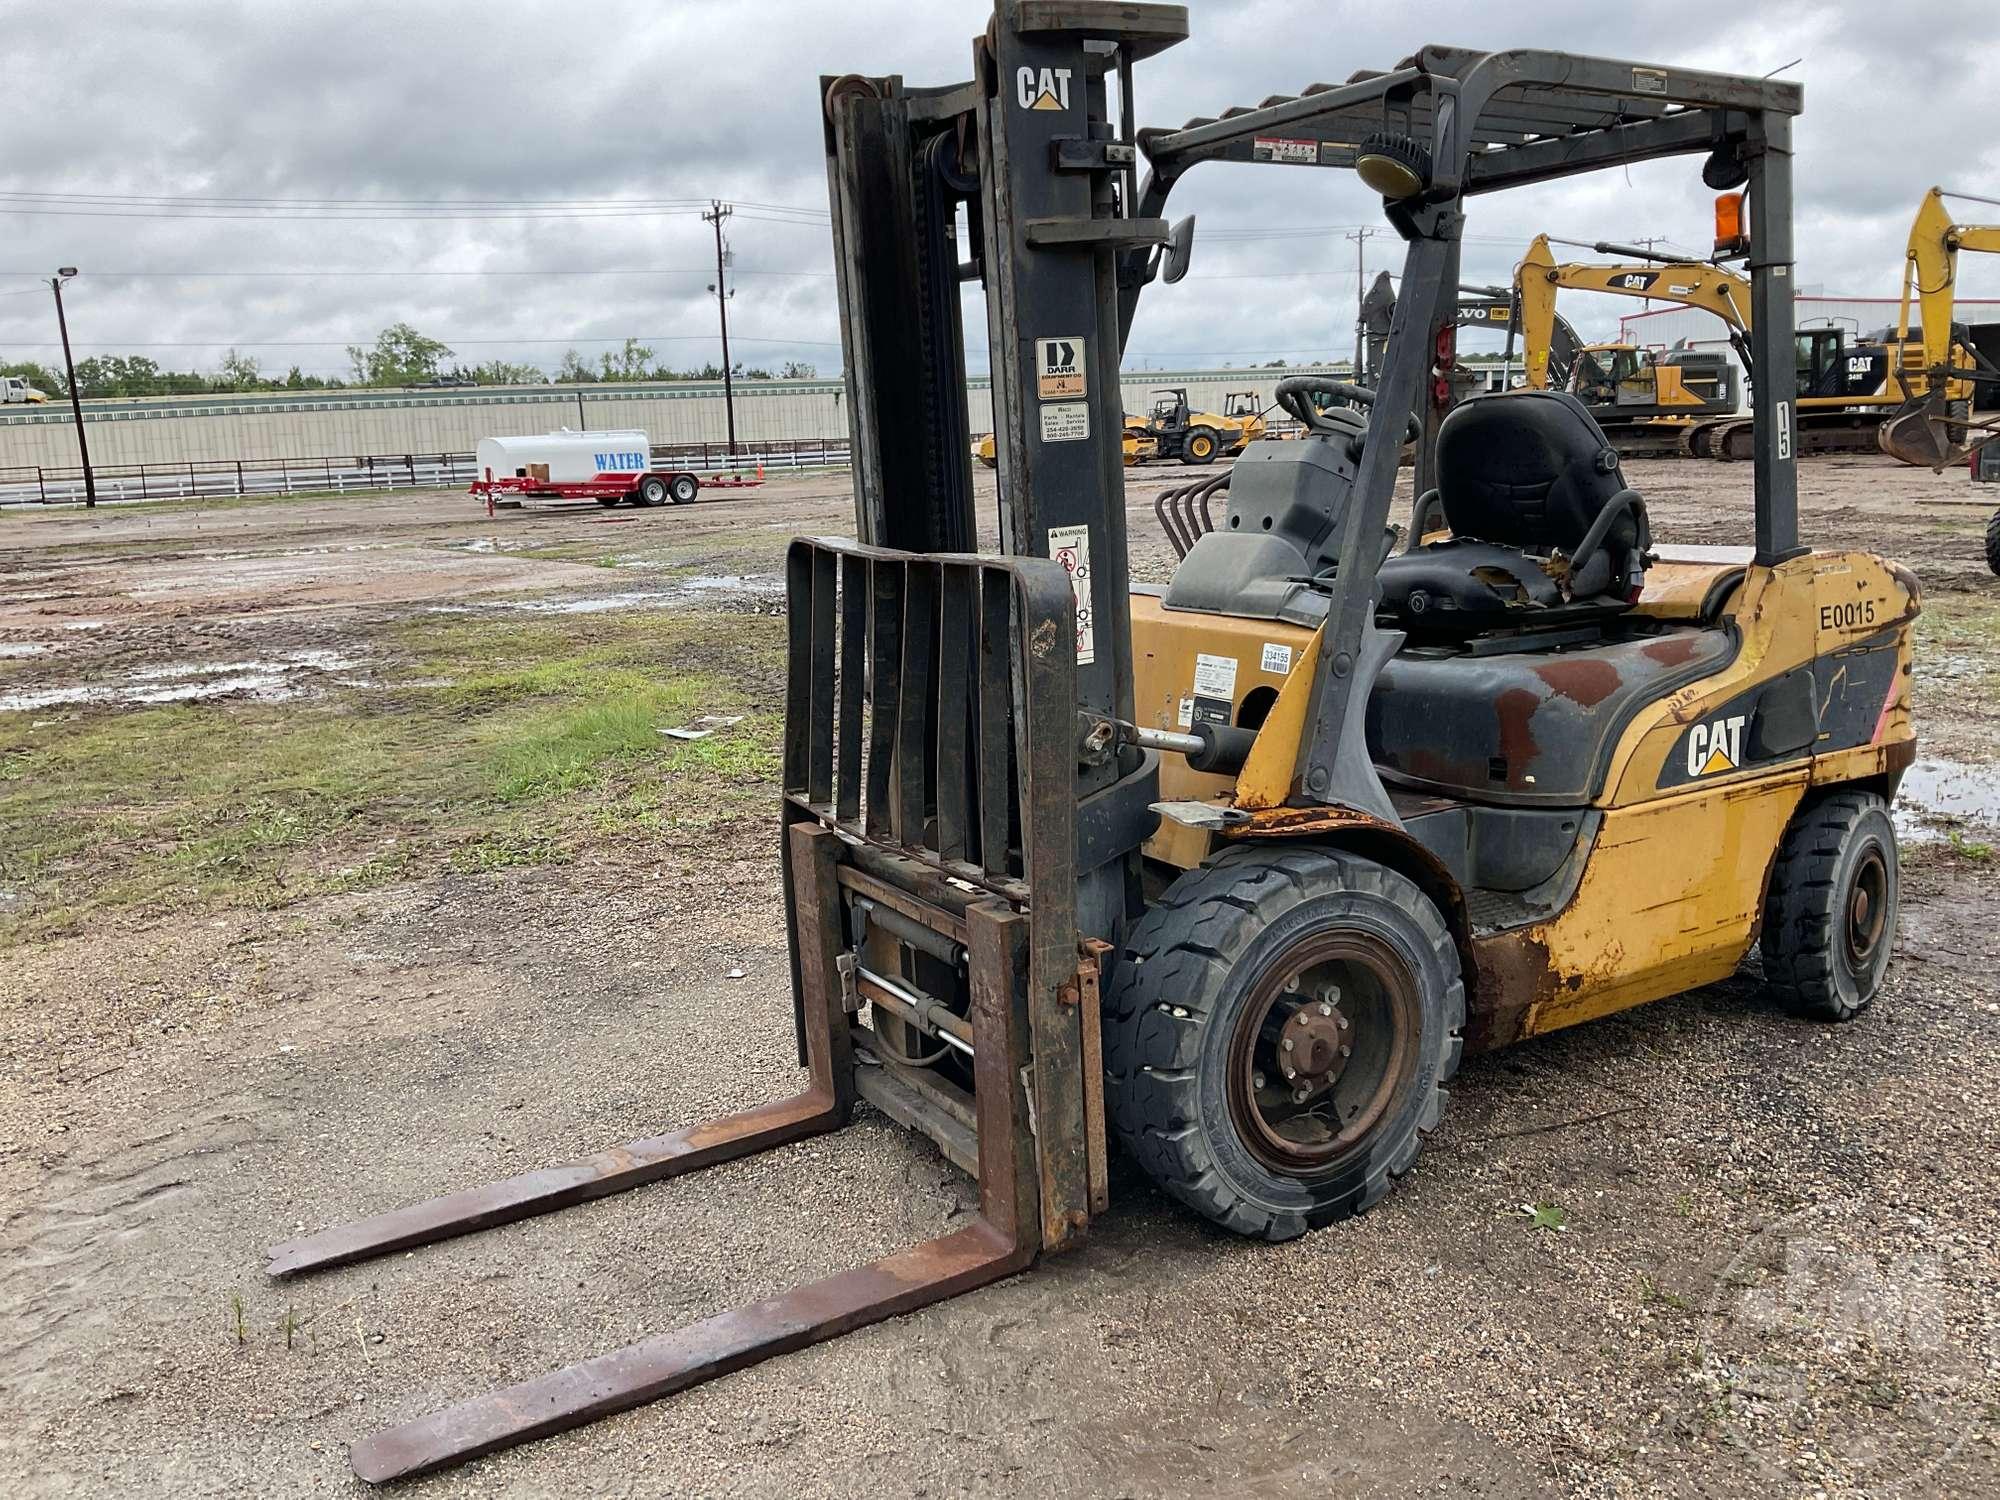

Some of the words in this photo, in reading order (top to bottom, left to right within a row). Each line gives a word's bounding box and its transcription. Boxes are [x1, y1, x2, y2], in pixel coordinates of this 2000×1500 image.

[1017, 66, 1071, 109] CAT
[1624, 274, 1647, 290] CAT
[1047, 366, 1075, 374] DARR
[1849, 356, 1873, 372] CAT
[594, 452, 645, 472] WATER
[1059, 527, 1087, 537] WARNING
[1820, 600, 1875, 631] E0015
[1264, 650, 1289, 663] 334155
[1687, 715, 1746, 777] CAT
